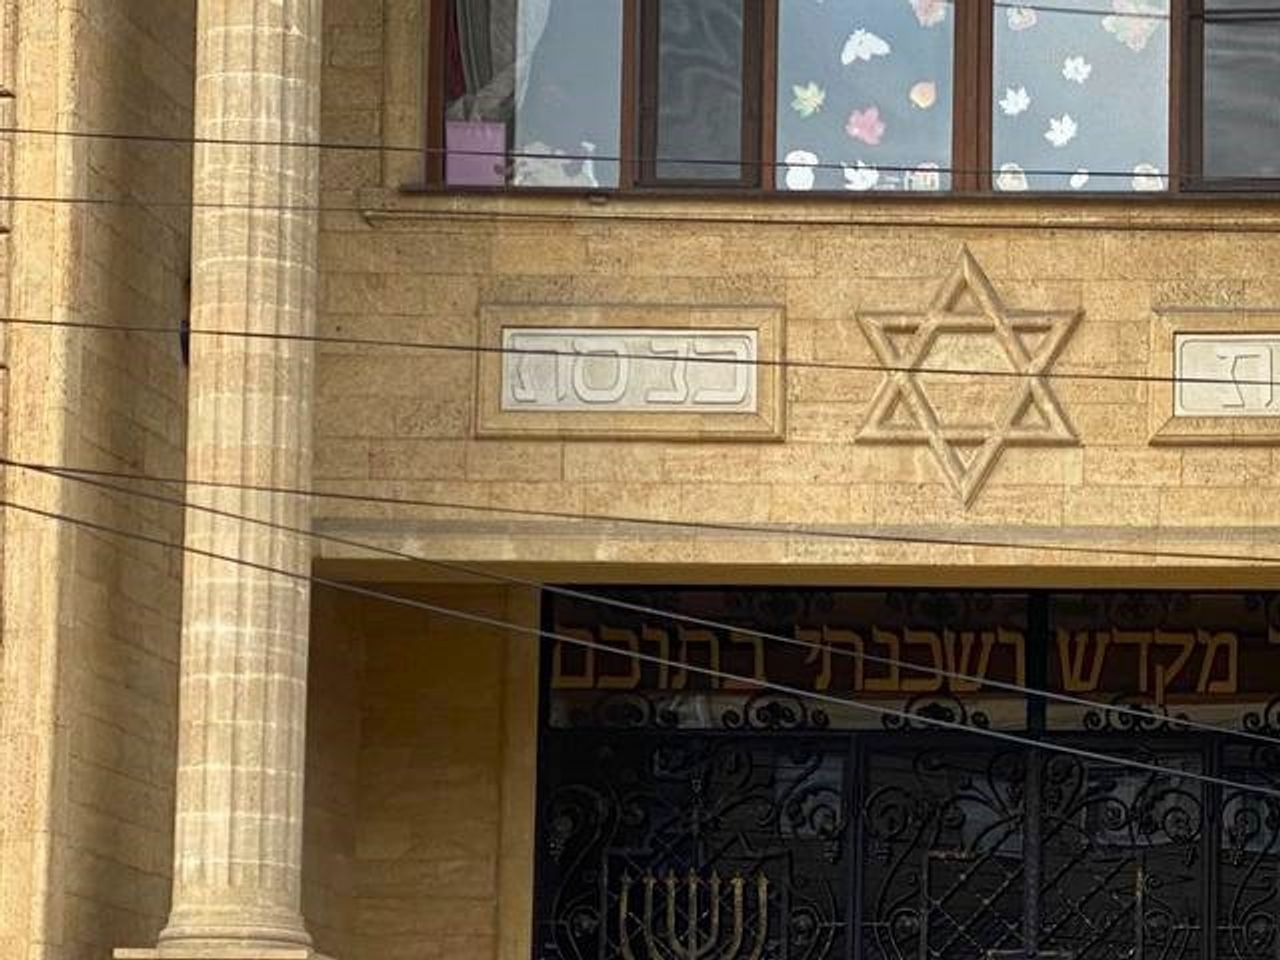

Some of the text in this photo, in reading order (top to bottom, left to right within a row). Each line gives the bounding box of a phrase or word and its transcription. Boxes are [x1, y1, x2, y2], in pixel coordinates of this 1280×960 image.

[512, 338, 747, 404] כנסת
[550, 624, 768, 690] בתוכם
[1056, 626, 1238, 708] מקדש
